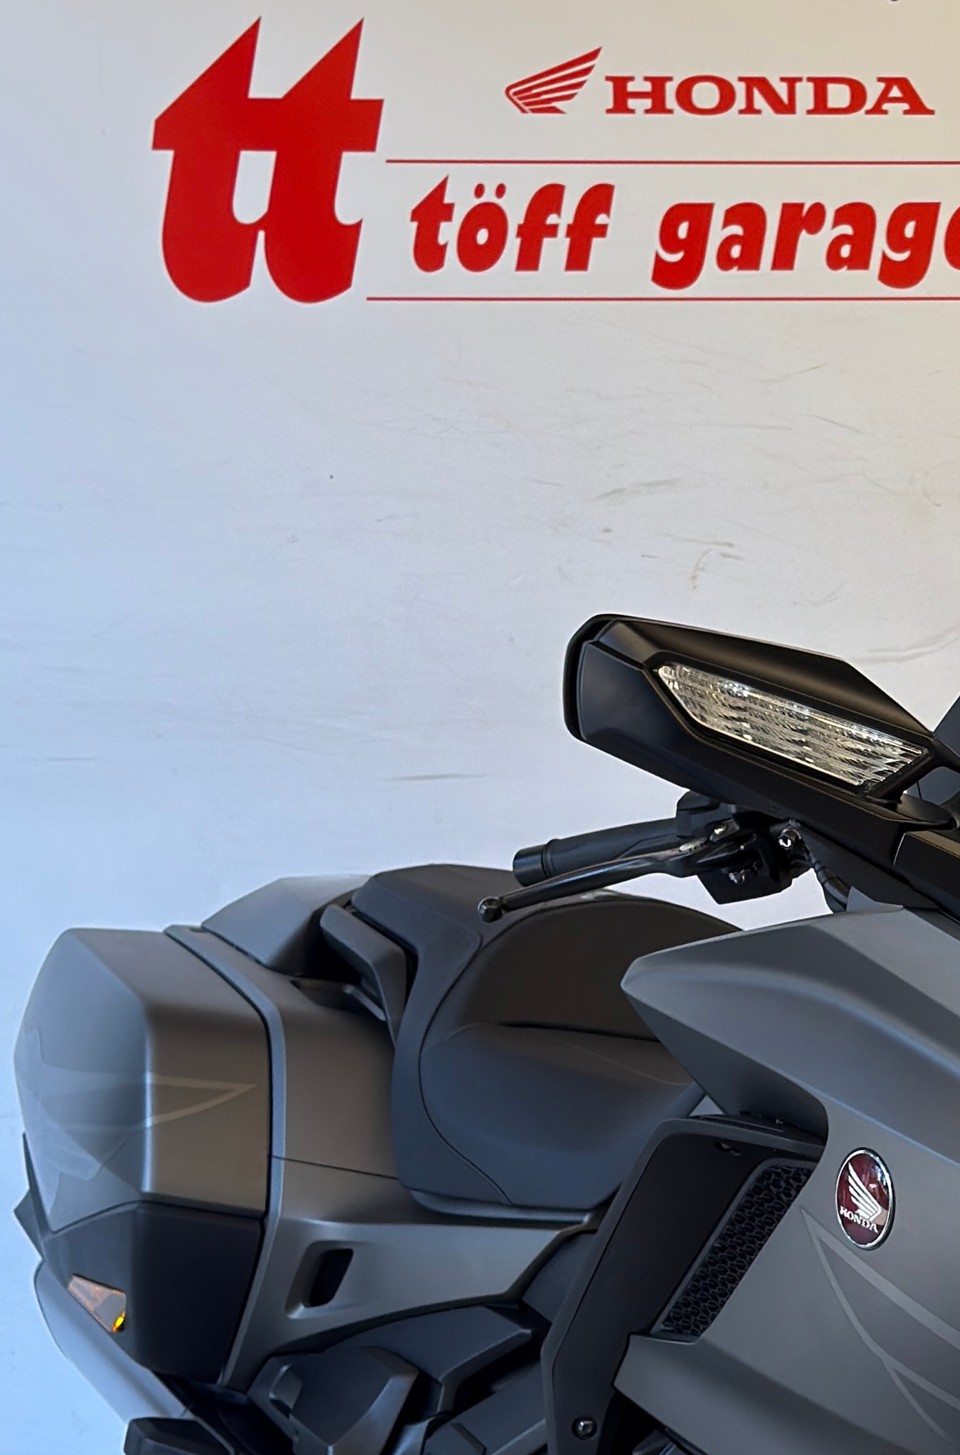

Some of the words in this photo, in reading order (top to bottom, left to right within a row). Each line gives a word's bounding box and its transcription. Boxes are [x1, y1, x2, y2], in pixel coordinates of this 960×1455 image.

[605, 75, 935, 116] HONDA
[410, 175, 615, 273] töff
[840, 1205, 879, 1234] HONDA
